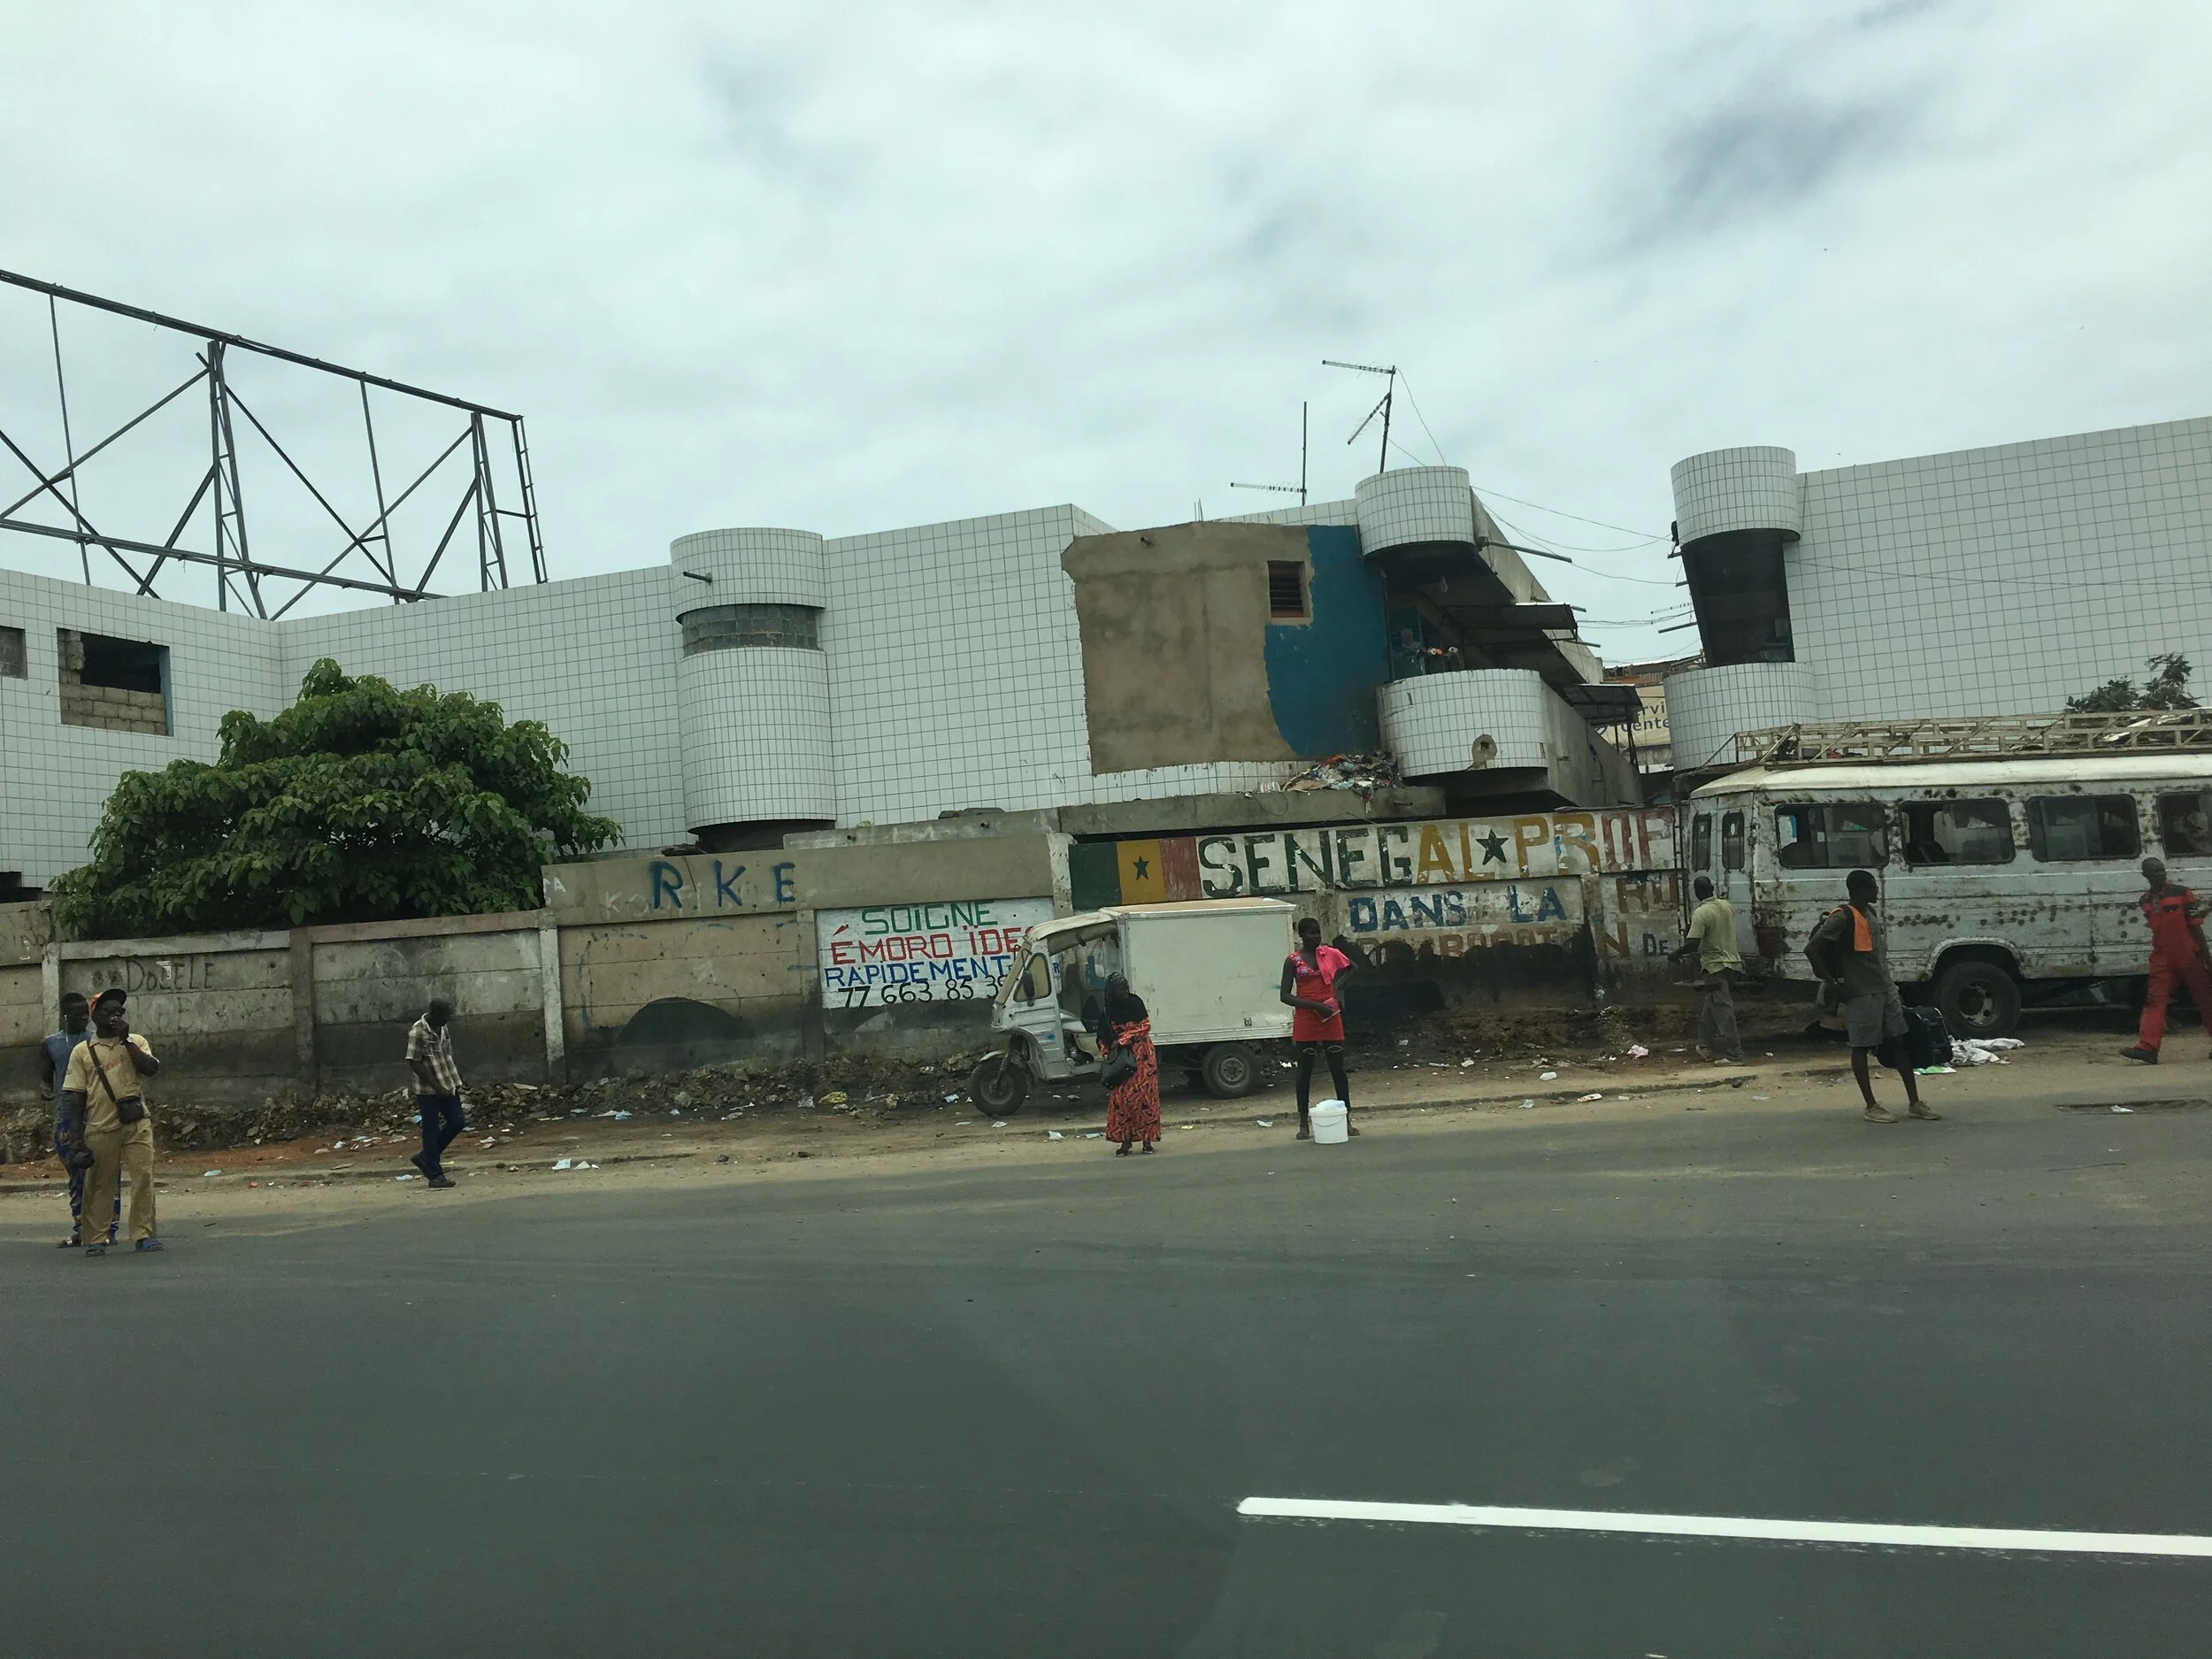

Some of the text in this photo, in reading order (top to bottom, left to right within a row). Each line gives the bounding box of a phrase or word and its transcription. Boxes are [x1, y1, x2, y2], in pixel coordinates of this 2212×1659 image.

[1621, 718, 1671, 732] Cente
[1198, 808, 1675, 900] SENEGAL PROP
[1348, 890, 1467, 933] DANS
[1508, 885, 1568, 923] LA
[963, 925, 1033, 956] ÏDE
[838, 985, 871, 1009] 77
[881, 979, 933, 1003] 663
[946, 976, 974, 1001] 85
